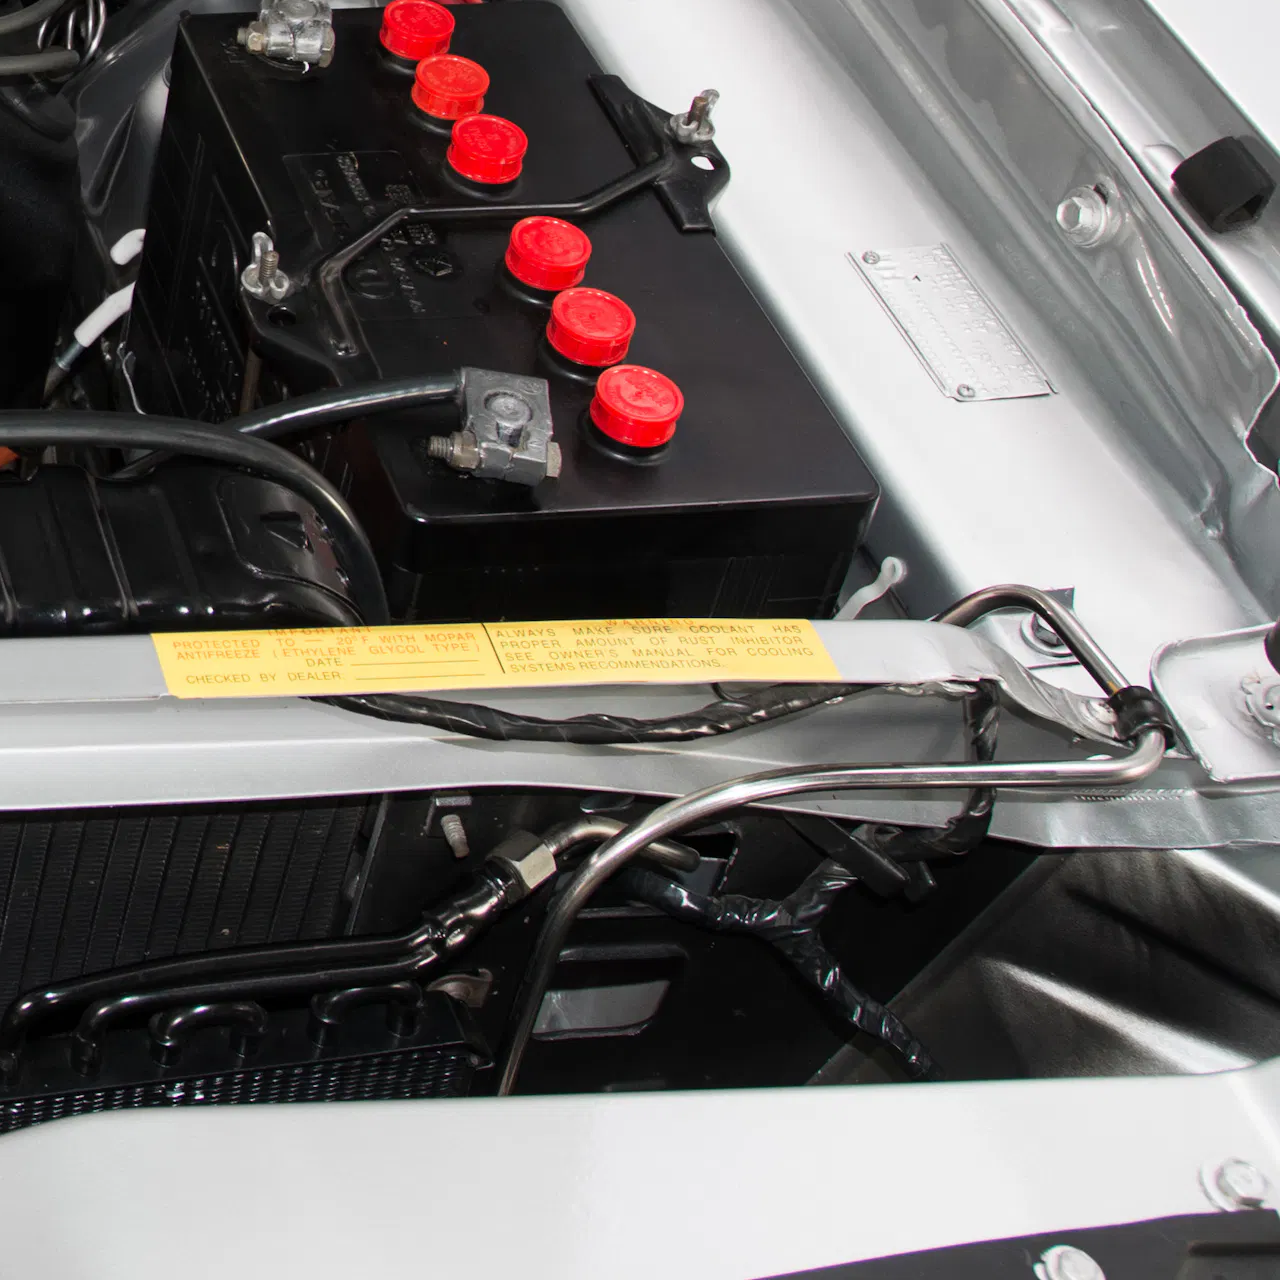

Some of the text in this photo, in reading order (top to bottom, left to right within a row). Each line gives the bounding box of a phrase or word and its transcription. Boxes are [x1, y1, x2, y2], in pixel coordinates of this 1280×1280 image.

[496, 624, 802, 639] ALWAYS MAKE SURE COOLANT HAS
[173, 640, 260, 649] PROTECTED
[379, 635, 415, 644] WITH
[425, 632, 475, 641] MOPAR
[500, 636, 803, 649] PROPER AMOUNT OF RUST INHIBITOR
[177, 649, 261, 660] ANTIFREEZE
[369, 644, 425, 654] GLYCOL
[505, 646, 814, 661] SEE OWNER'S MANUAL FOR COOLING
[306, 658, 343, 667] DATE
[510, 661, 576, 673] SYSTEMS
[186, 674, 250, 684] CHECKED
[260, 673, 276, 682] BY
